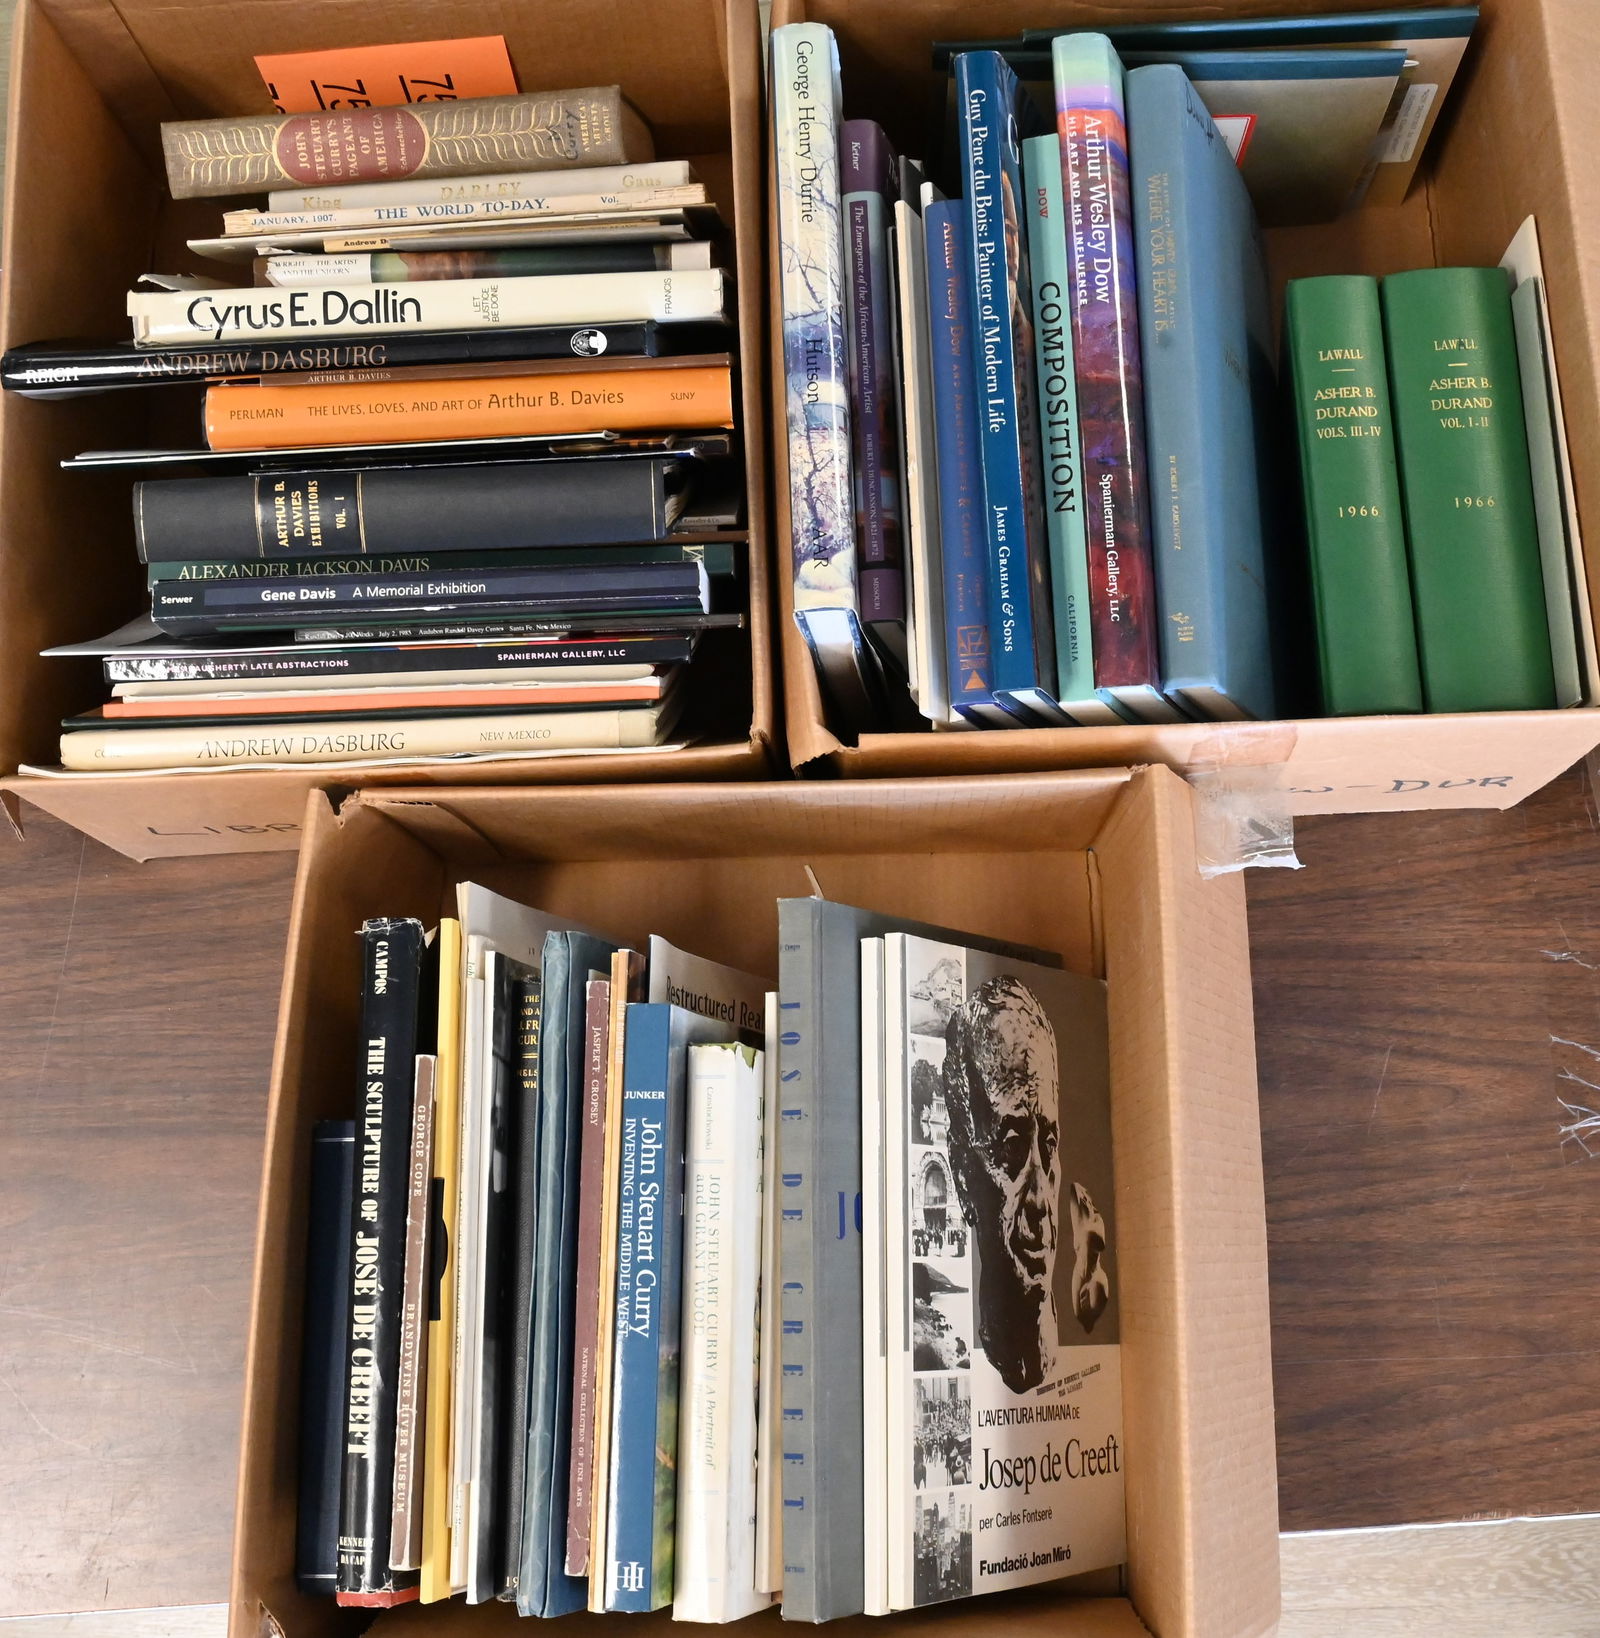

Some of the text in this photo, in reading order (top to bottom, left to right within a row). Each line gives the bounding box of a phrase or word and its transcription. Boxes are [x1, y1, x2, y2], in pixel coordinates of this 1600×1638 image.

[316, 119, 327, 180] STEUART
[330, 118, 342, 176] CURRY'S
[347, 116, 358, 177] PAGEANT
[360, 136, 370, 155] OF
[375, 113, 388, 174] AMERICA
[441, 182, 521, 200] DARLEY
[601, 195, 619, 204] Vol.
[251, 215, 309, 226] JANUARY,
[374, 198, 549, 219] THE WORLD TO-DAY.
[793, 40, 823, 404] George Henry Durrie Hutson
[851, 141, 869, 301] Ketner The Emergence of the
[1068, 116, 1088, 305] HIS ART AND HIS INFLUENCE
[1084, 115, 1112, 304] Arthur Wesley Dow
[343, 239, 378, 247] Andrew
[1148, 173, 1167, 314] WHERE YOUR HEART
[187, 289, 421, 339] Cyrus E. Dallin
[481, 288, 490, 322] JUSTICE
[492, 310, 499, 322] BE
[137, 346, 388, 377] ANDREW DASBURG
[966, 89, 1015, 652] Guy du Bois: Painter of Modern Life JAMES GRAHAM & SONS
[1319, 349, 1363, 361] LAWALL
[307, 372, 391, 382] ARTHUR DAVIES
[1429, 378, 1492, 390] ASHER B.
[230, 389, 695, 420] PERLMAN THE LIVES, LOVES, AND ART OF Arthur B. Davies SUNY
[1314, 387, 1376, 400] ASHER B.
[1431, 398, 1492, 410] DURAND
[1038, 188, 1078, 662] DOW COMPOSITION CALIFORNIA
[1316, 407, 1377, 419] DURAND
[1440, 418, 1465, 428] VOL.
[1317, 427, 1347, 438] VOLS.
[274, 480, 289, 547] ARTHUR B.
[292, 490, 305, 537] DAVIES
[309, 480, 321, 546] EXHIBITIONS
[1339, 506, 1379, 517] 1966
[1455, 497, 1495, 507] 1966
[335, 508, 345, 529] VOL.
[1100, 474, 1119, 621] Spanierman Gallery, LLC
[180, 558, 429, 579] ALEXANDER JACKSON DAVIS
[161, 581, 486, 605] Serwer Gene Davis A Memorial Exhibition
[250, 662, 273, 670] LATE
[276, 660, 349, 669] ABSTRACTIONS
[497, 651, 559, 660] SPANIERMAN
[562, 650, 605, 659] GALLERY,
[197, 729, 551, 758] ANDREW DASBURG NEW MEXICO
[666, 975, 735, 1022] Restructured
[592, 1026, 601, 1066] JASPER
[589, 1080, 599, 1126] CROPSEY
[624, 1091, 665, 1099] JUNKER
[348, 941, 389, 1459] CAMPOS THE SCULPTURE OF JOSÉ DE CREEFT
[620, 1118, 636, 1291] INVENTING THE MIDDLE
[635, 1117, 662, 1338] John Steuart Curry
[706, 1176, 720, 1371] JOHN STEUART CURRY
[396, 1105, 426, 1513] GEORGE COPE BRANDYWINE RIVER MUSEUM
[578, 1393, 586, 1443] COLLECTION
[978, 1404, 1080, 1427] L'AVENTURA HUMANA DE
[579, 1447, 584, 1458] OF
[980, 1435, 1119, 1494] Josep de Creeft
[979, 1512, 1020, 1532] per Carles
[980, 1545, 1071, 1576] Fundació Joan Miró
